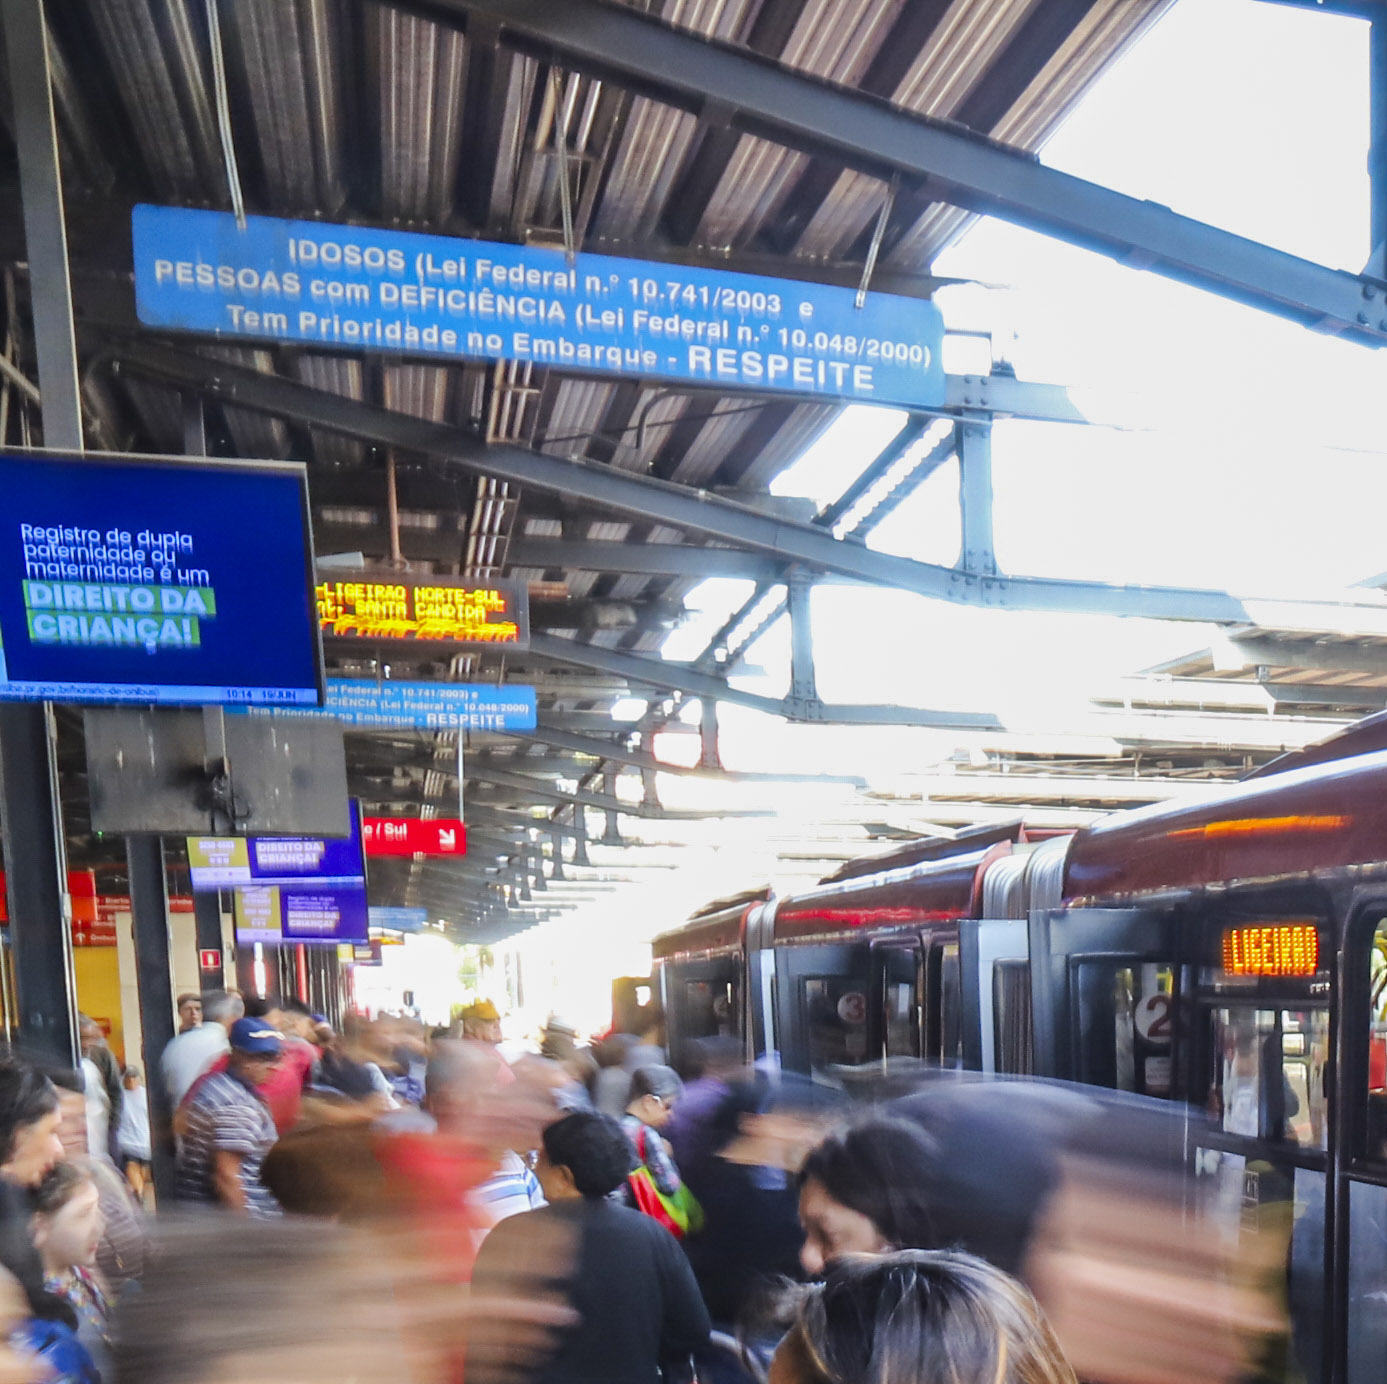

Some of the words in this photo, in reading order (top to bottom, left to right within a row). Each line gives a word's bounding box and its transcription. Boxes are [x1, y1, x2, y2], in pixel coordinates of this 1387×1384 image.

[288, 238, 405, 270] IDOSOS
[416, 253, 466, 279] (Lei
[476, 258, 576, 288] Federal
[629, 277, 781, 313] 10.741/2003
[800, 301, 813, 316] e
[155, 259, 300, 293] PESSOAS
[311, 278, 369, 302] com
[381, 282, 566, 320] DEFICIÊNCIA
[576, 303, 623, 328] (Lei
[633, 310, 728, 339] Federal
[778, 327, 932, 369] 10.048/2000)
[227, 305, 287, 331] Tem
[300, 312, 457, 345] Prioridade
[468, 331, 502, 350] no
[513, 333, 657, 366] Embarque
[688, 345, 874, 390] RESPEITE
[21, 523, 100, 544] Registro
[106, 528, 131, 542] de
[137, 530, 192, 549] dupla
[24, 544, 145, 562] paternidade
[151, 552, 175, 563] ou
[27, 561, 154, 579] maternidade
[160, 564, 172, 580] é
[178, 569, 209, 583] um
[28, 583, 154, 613] DIREITO
[160, 588, 206, 614] DA
[414, 586, 503, 607] NORTE-SUL
[356, 600, 407, 619] SANTA
[416, 602, 487, 622] CANDIDA
[33, 614, 192, 648] CRIANÇA!
[341, 685, 381, 695] Federal
[326, 695, 377, 707] ICIÊNCIA
[404, 700, 443, 711] Federal
[356, 712, 416, 724] Embarque
[427, 713, 505, 727] RESPEITE
[385, 822, 408, 836] Sul
[1231, 925, 1318, 970] LIGEIRAO
[1147, 995, 1173, 1038] 2
